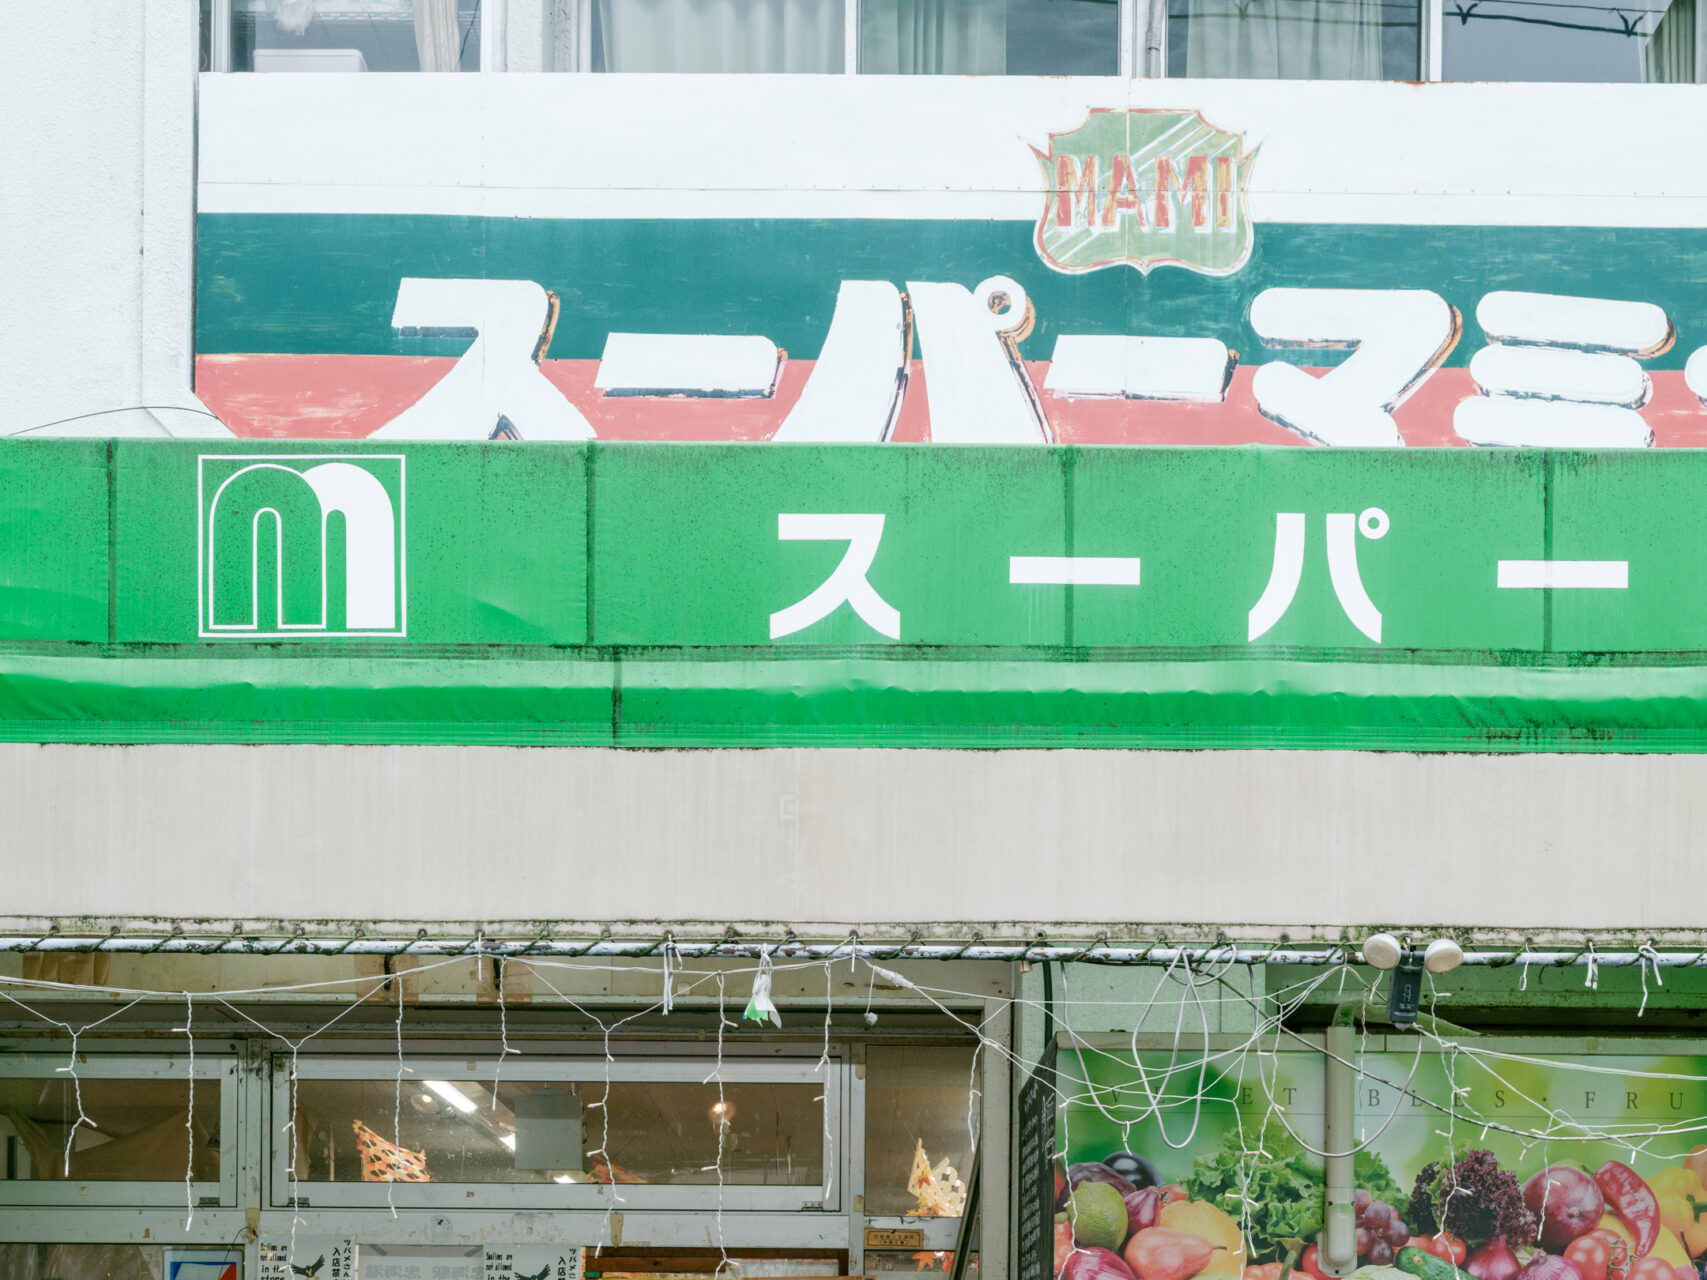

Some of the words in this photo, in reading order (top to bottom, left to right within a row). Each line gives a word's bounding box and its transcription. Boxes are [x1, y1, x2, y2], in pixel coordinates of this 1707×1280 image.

[1054, 153, 1237, 234] MAMI
[366, 274, 1707, 447] スーパーマミ
[769, 507, 1629, 644] スーパー
[261, 1265, 269, 1273] in
